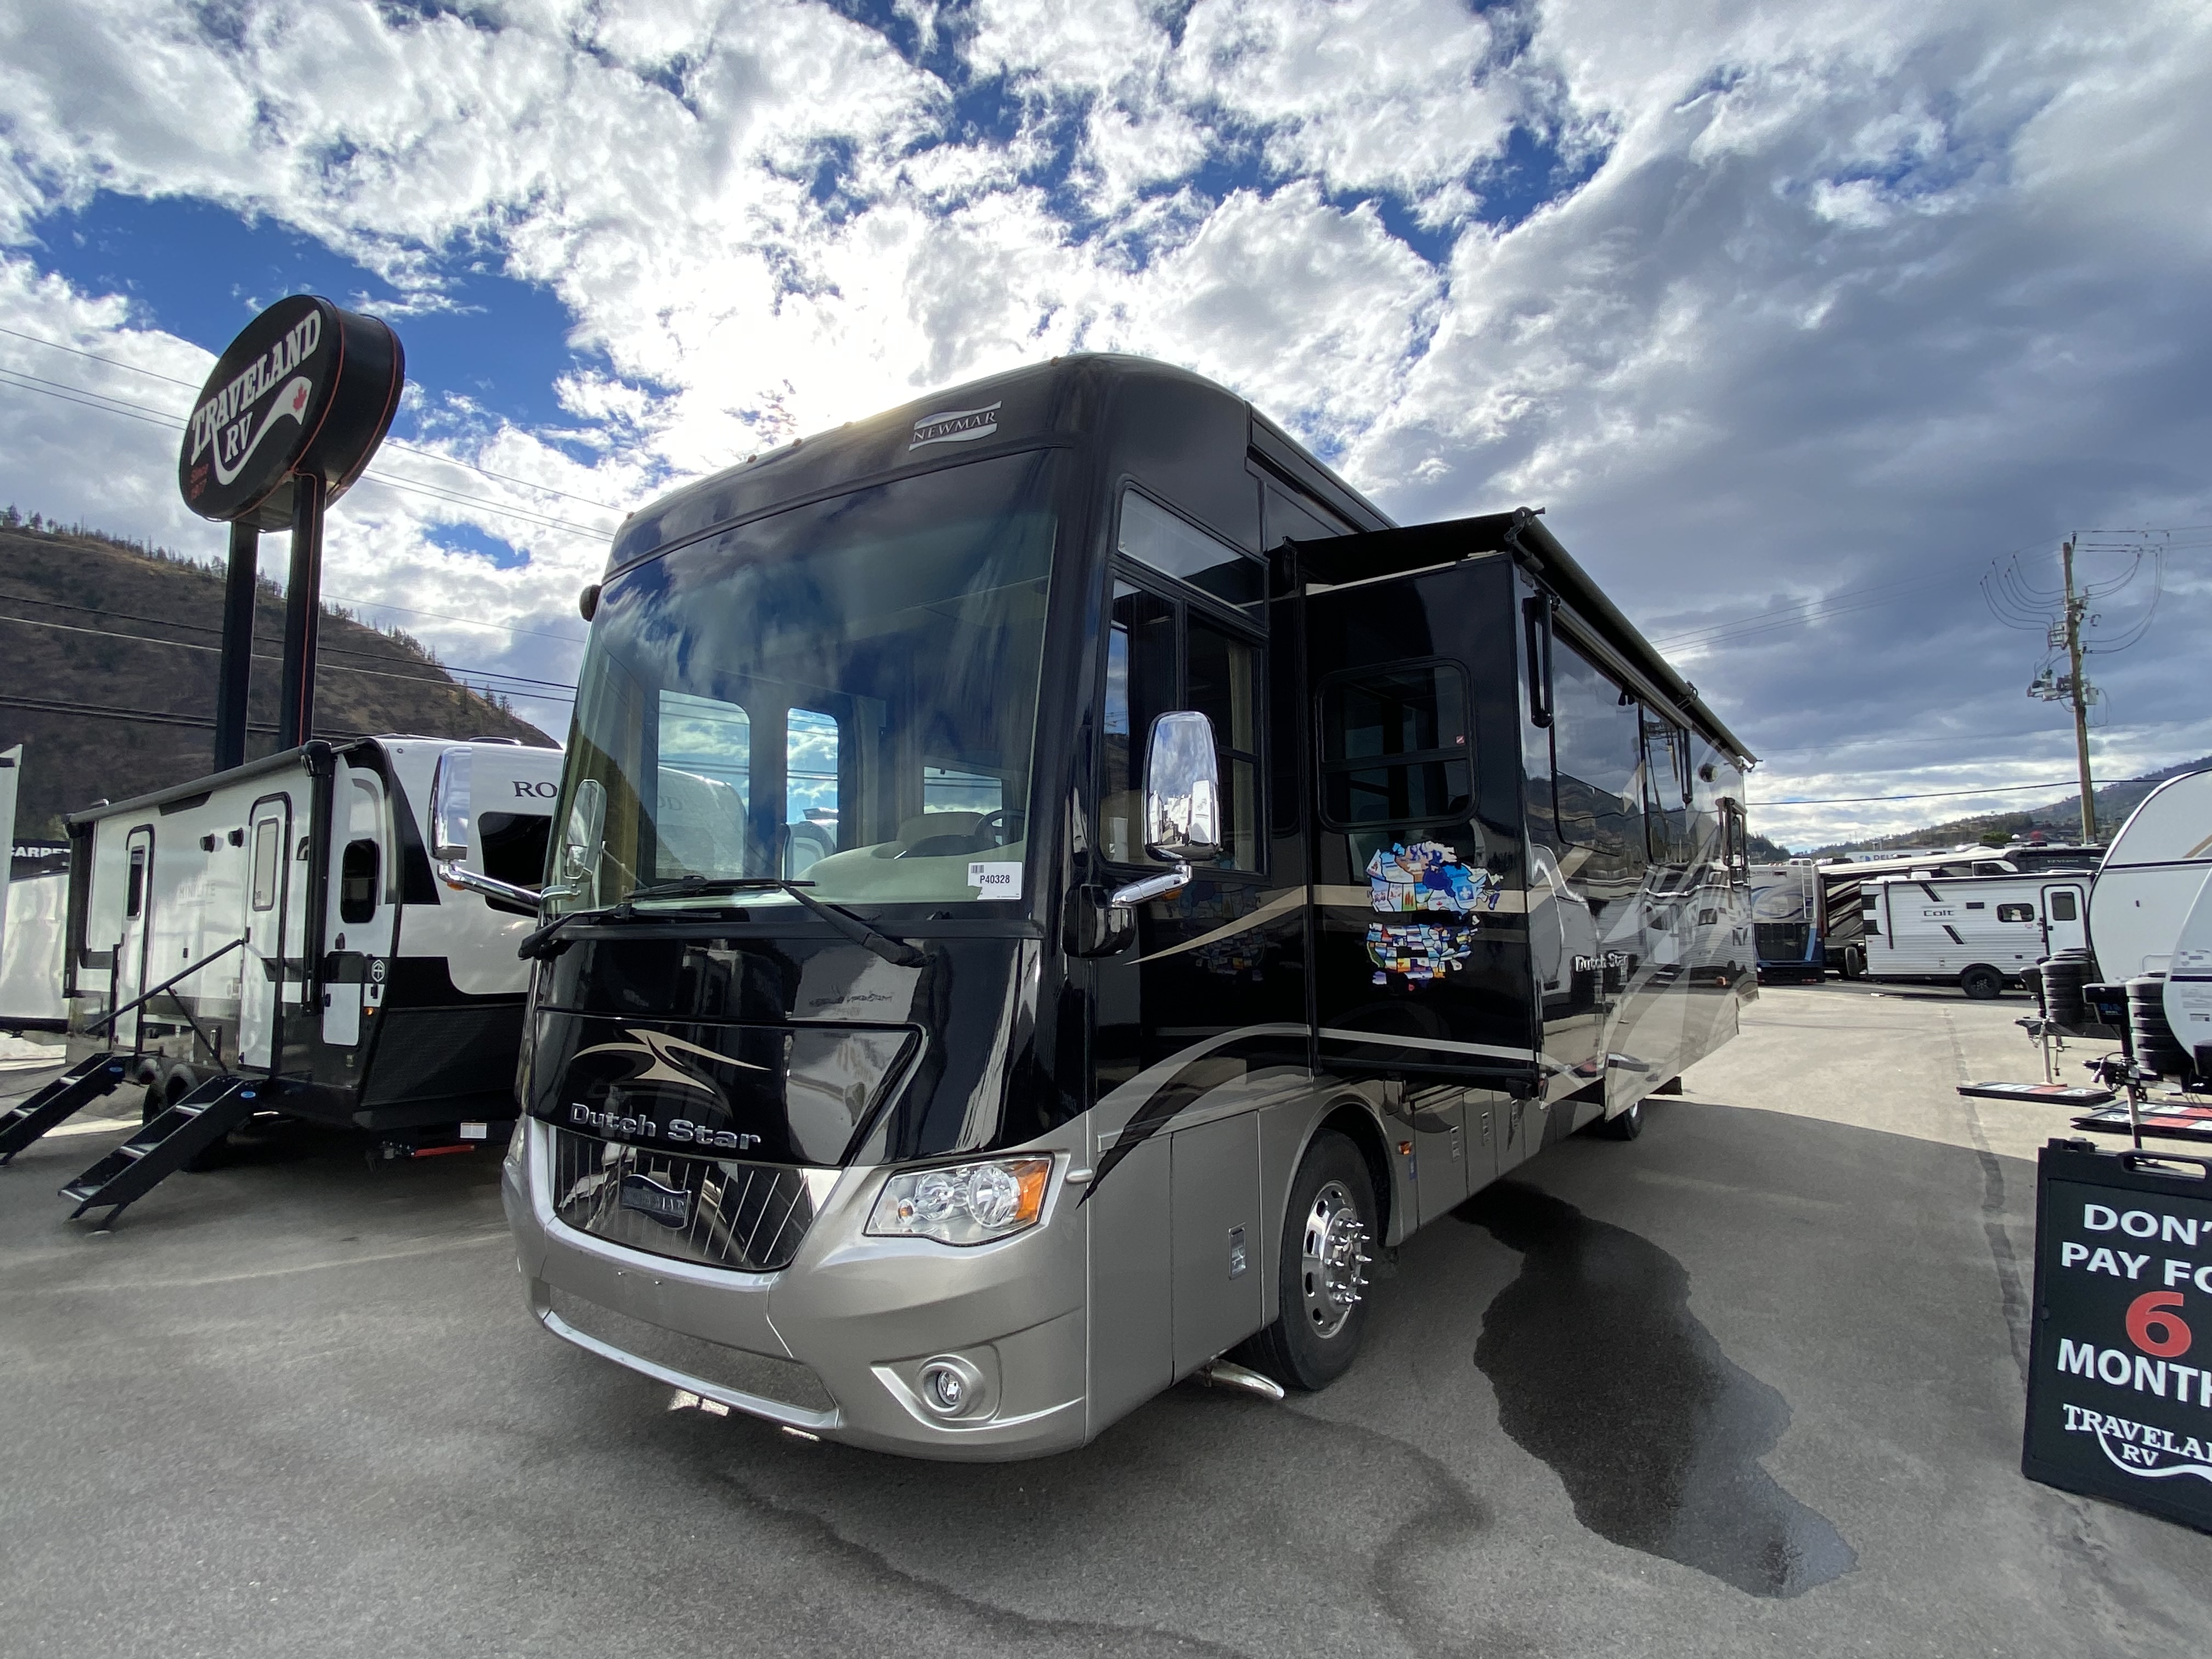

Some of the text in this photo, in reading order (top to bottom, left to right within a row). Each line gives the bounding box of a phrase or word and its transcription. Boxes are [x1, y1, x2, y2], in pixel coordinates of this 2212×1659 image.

[191, 309, 321, 466] TRAVELAND
[224, 411, 253, 463] RV
[912, 411, 997, 442] NEWMAR
[11, 846, 71, 857] ARPE
[979, 874, 1010, 884] P40328
[1575, 953, 1607, 972] Dutch
[570, 1103, 761, 1150] Dutch Star
[2061, 1242, 2151, 1279] PAY
[2125, 1291, 2192, 1357] 6
[2063, 1403, 2212, 1464] TRAVELA
[2121, 1443, 2159, 1466] RV
